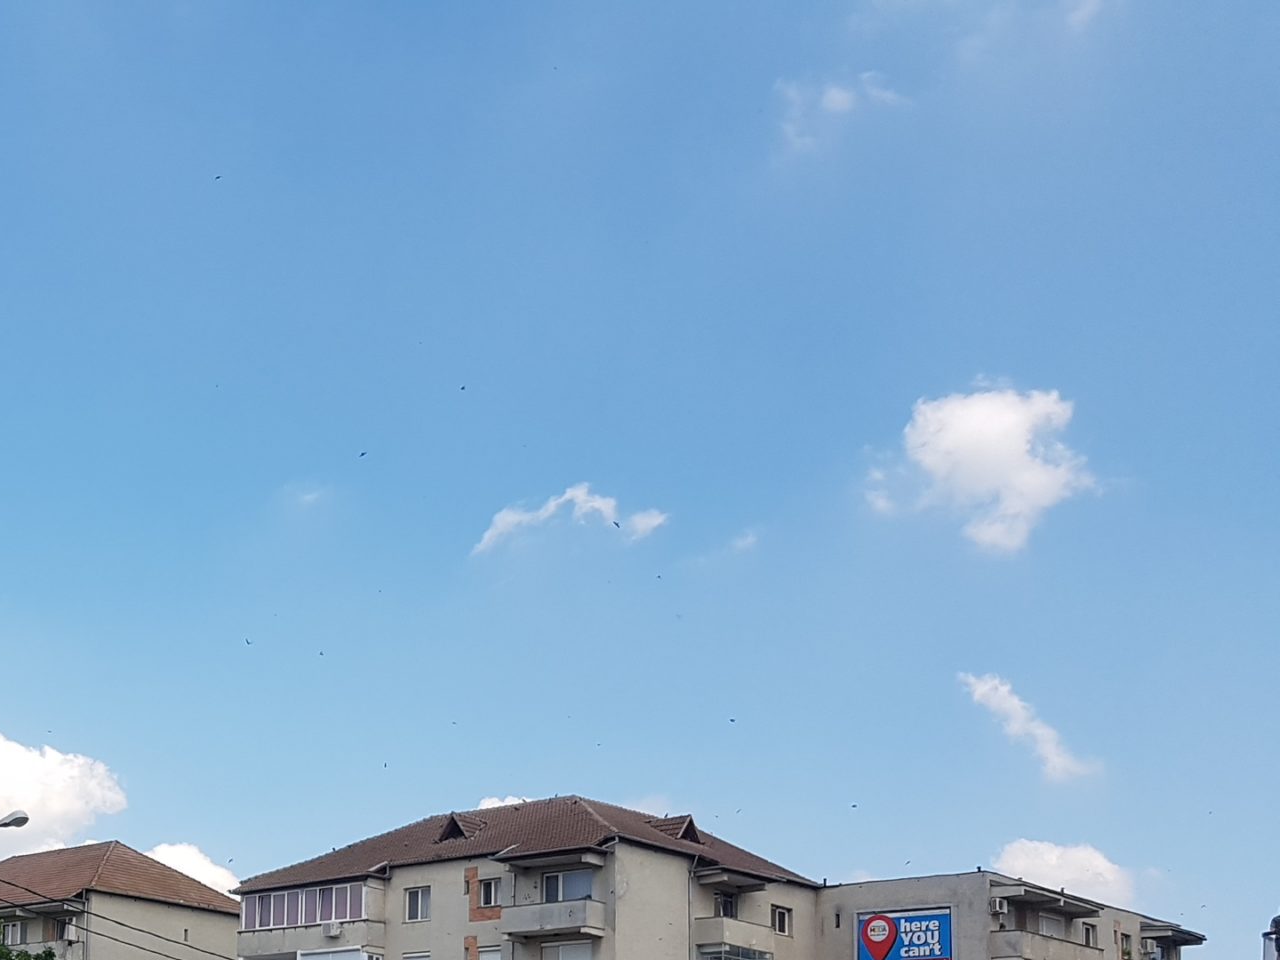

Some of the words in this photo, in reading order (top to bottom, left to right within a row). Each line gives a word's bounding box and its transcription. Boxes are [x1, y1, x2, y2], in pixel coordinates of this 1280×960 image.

[900, 919, 939, 931] here
[900, 931, 939, 945] YOU
[900, 943, 942, 957] can't
